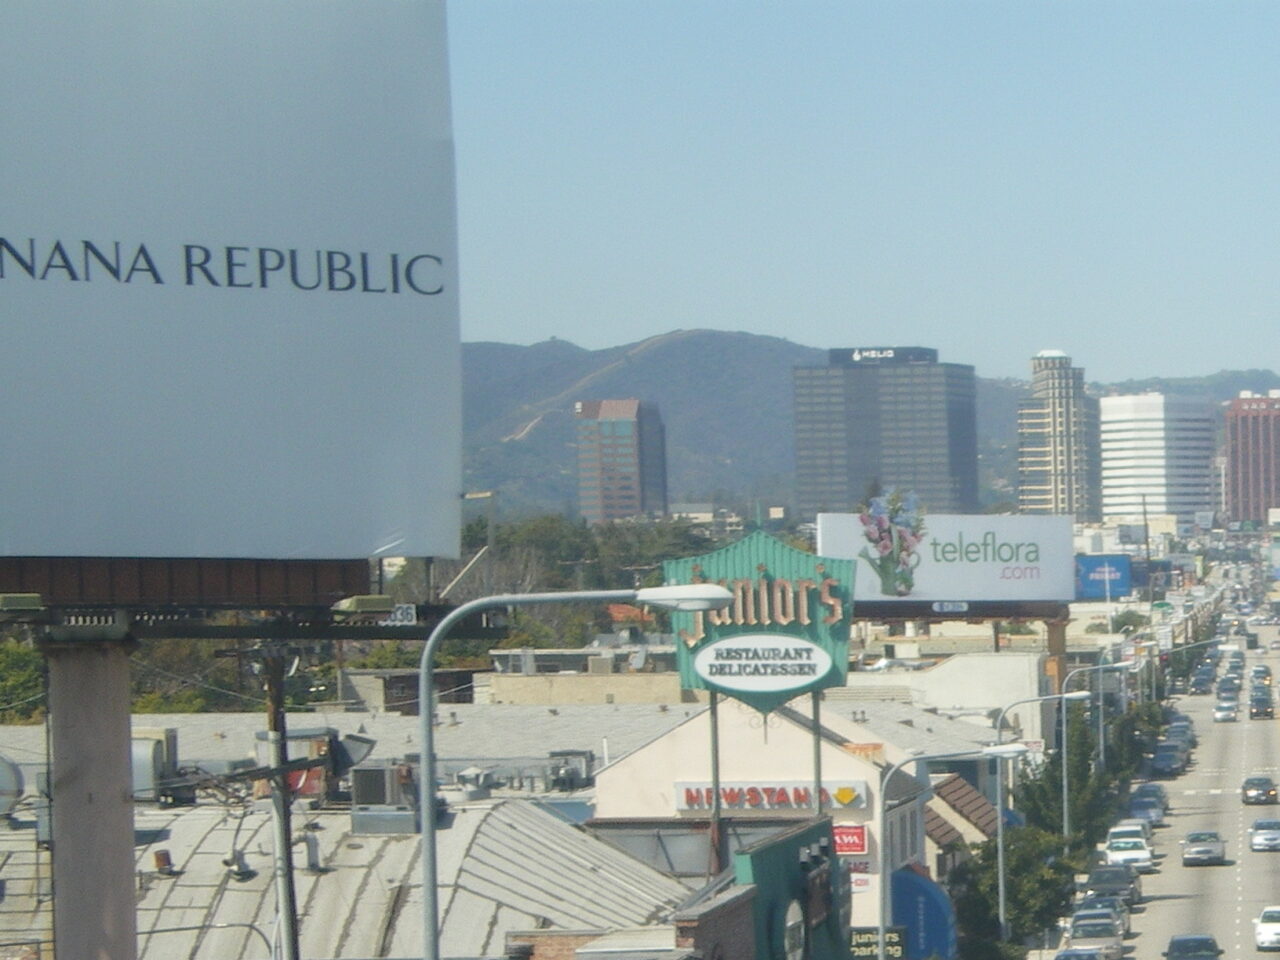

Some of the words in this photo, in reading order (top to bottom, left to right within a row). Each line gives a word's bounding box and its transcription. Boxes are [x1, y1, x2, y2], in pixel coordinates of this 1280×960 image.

[183, 243, 445, 296] REPUBLIC
[930, 531, 1040, 563] teleflora
[1000, 565, 1041, 580] .com
[714, 647, 814, 662] RESTAURANT
[708, 663, 817, 677] DELICATESSEN
[684, 786, 831, 807] NEWSTAND
[851, 931, 900, 946] junirs
[849, 945, 903, 958] arkng
